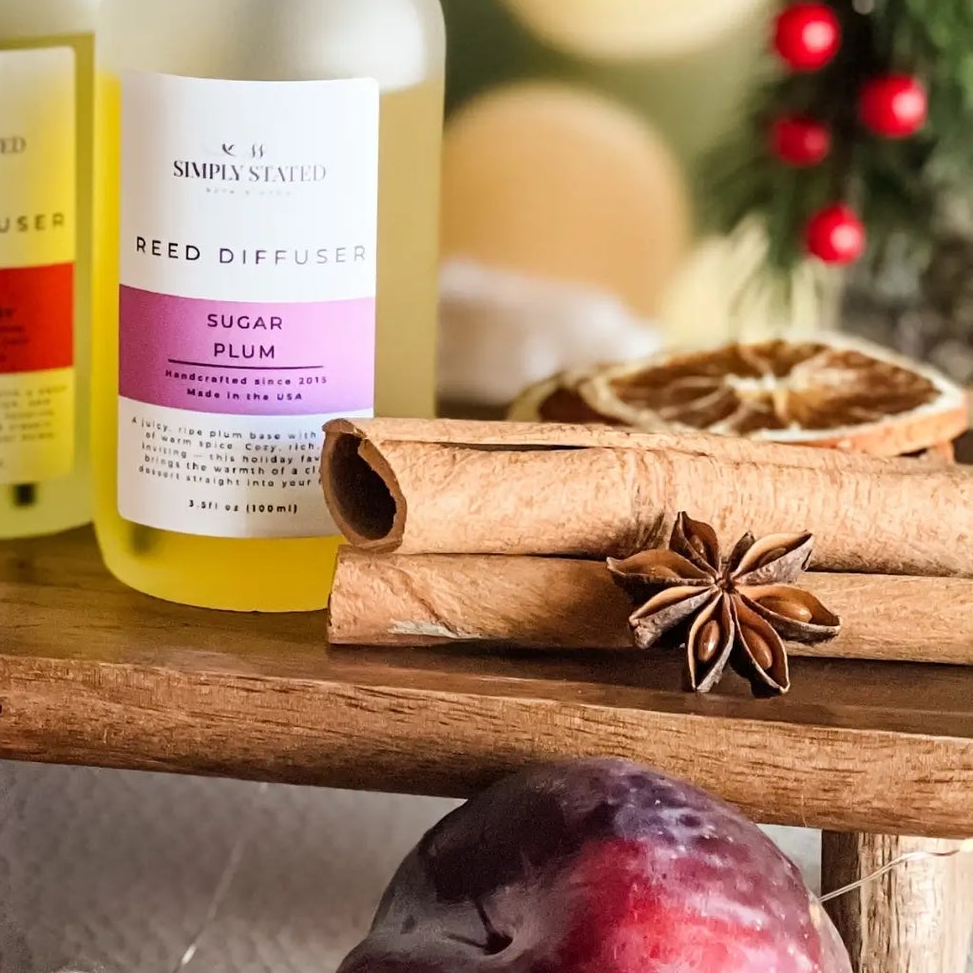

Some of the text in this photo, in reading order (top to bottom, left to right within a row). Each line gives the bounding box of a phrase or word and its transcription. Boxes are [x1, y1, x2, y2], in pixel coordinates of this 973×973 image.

[173, 160, 327, 183] SIMPLY STATED
[136, 236, 366, 265] REED DIFFUSER
[207, 313, 283, 330] SUGAR
[213, 343, 275, 359] PLUM
[165, 369, 327, 385] Handcrafted since 2015
[187, 389, 303, 401] Made in the USA
[145, 431, 156, 439] of
[161, 435, 192, 446] warm
[178, 427, 203, 436] ripe
[209, 430, 243, 439] plum
[249, 431, 281, 440] base
[288, 431, 317, 439] with
[141, 441, 187, 459] inviting
[209, 453, 235, 463] this
[243, 455, 293, 465] holiday
[144, 453, 181, 469] brings
[187, 461, 207, 471] the
[213, 465, 265, 475] warmth
[271, 467, 285, 475] of
[291, 467, 298, 475] a
[139, 465, 180, 481] dessert
[187, 475, 240, 487] straight
[247, 479, 275, 487] into
[281, 479, 311, 489] your
[225, 504, 239, 513] oz
[246, 503, 299, 514] (100ml)
